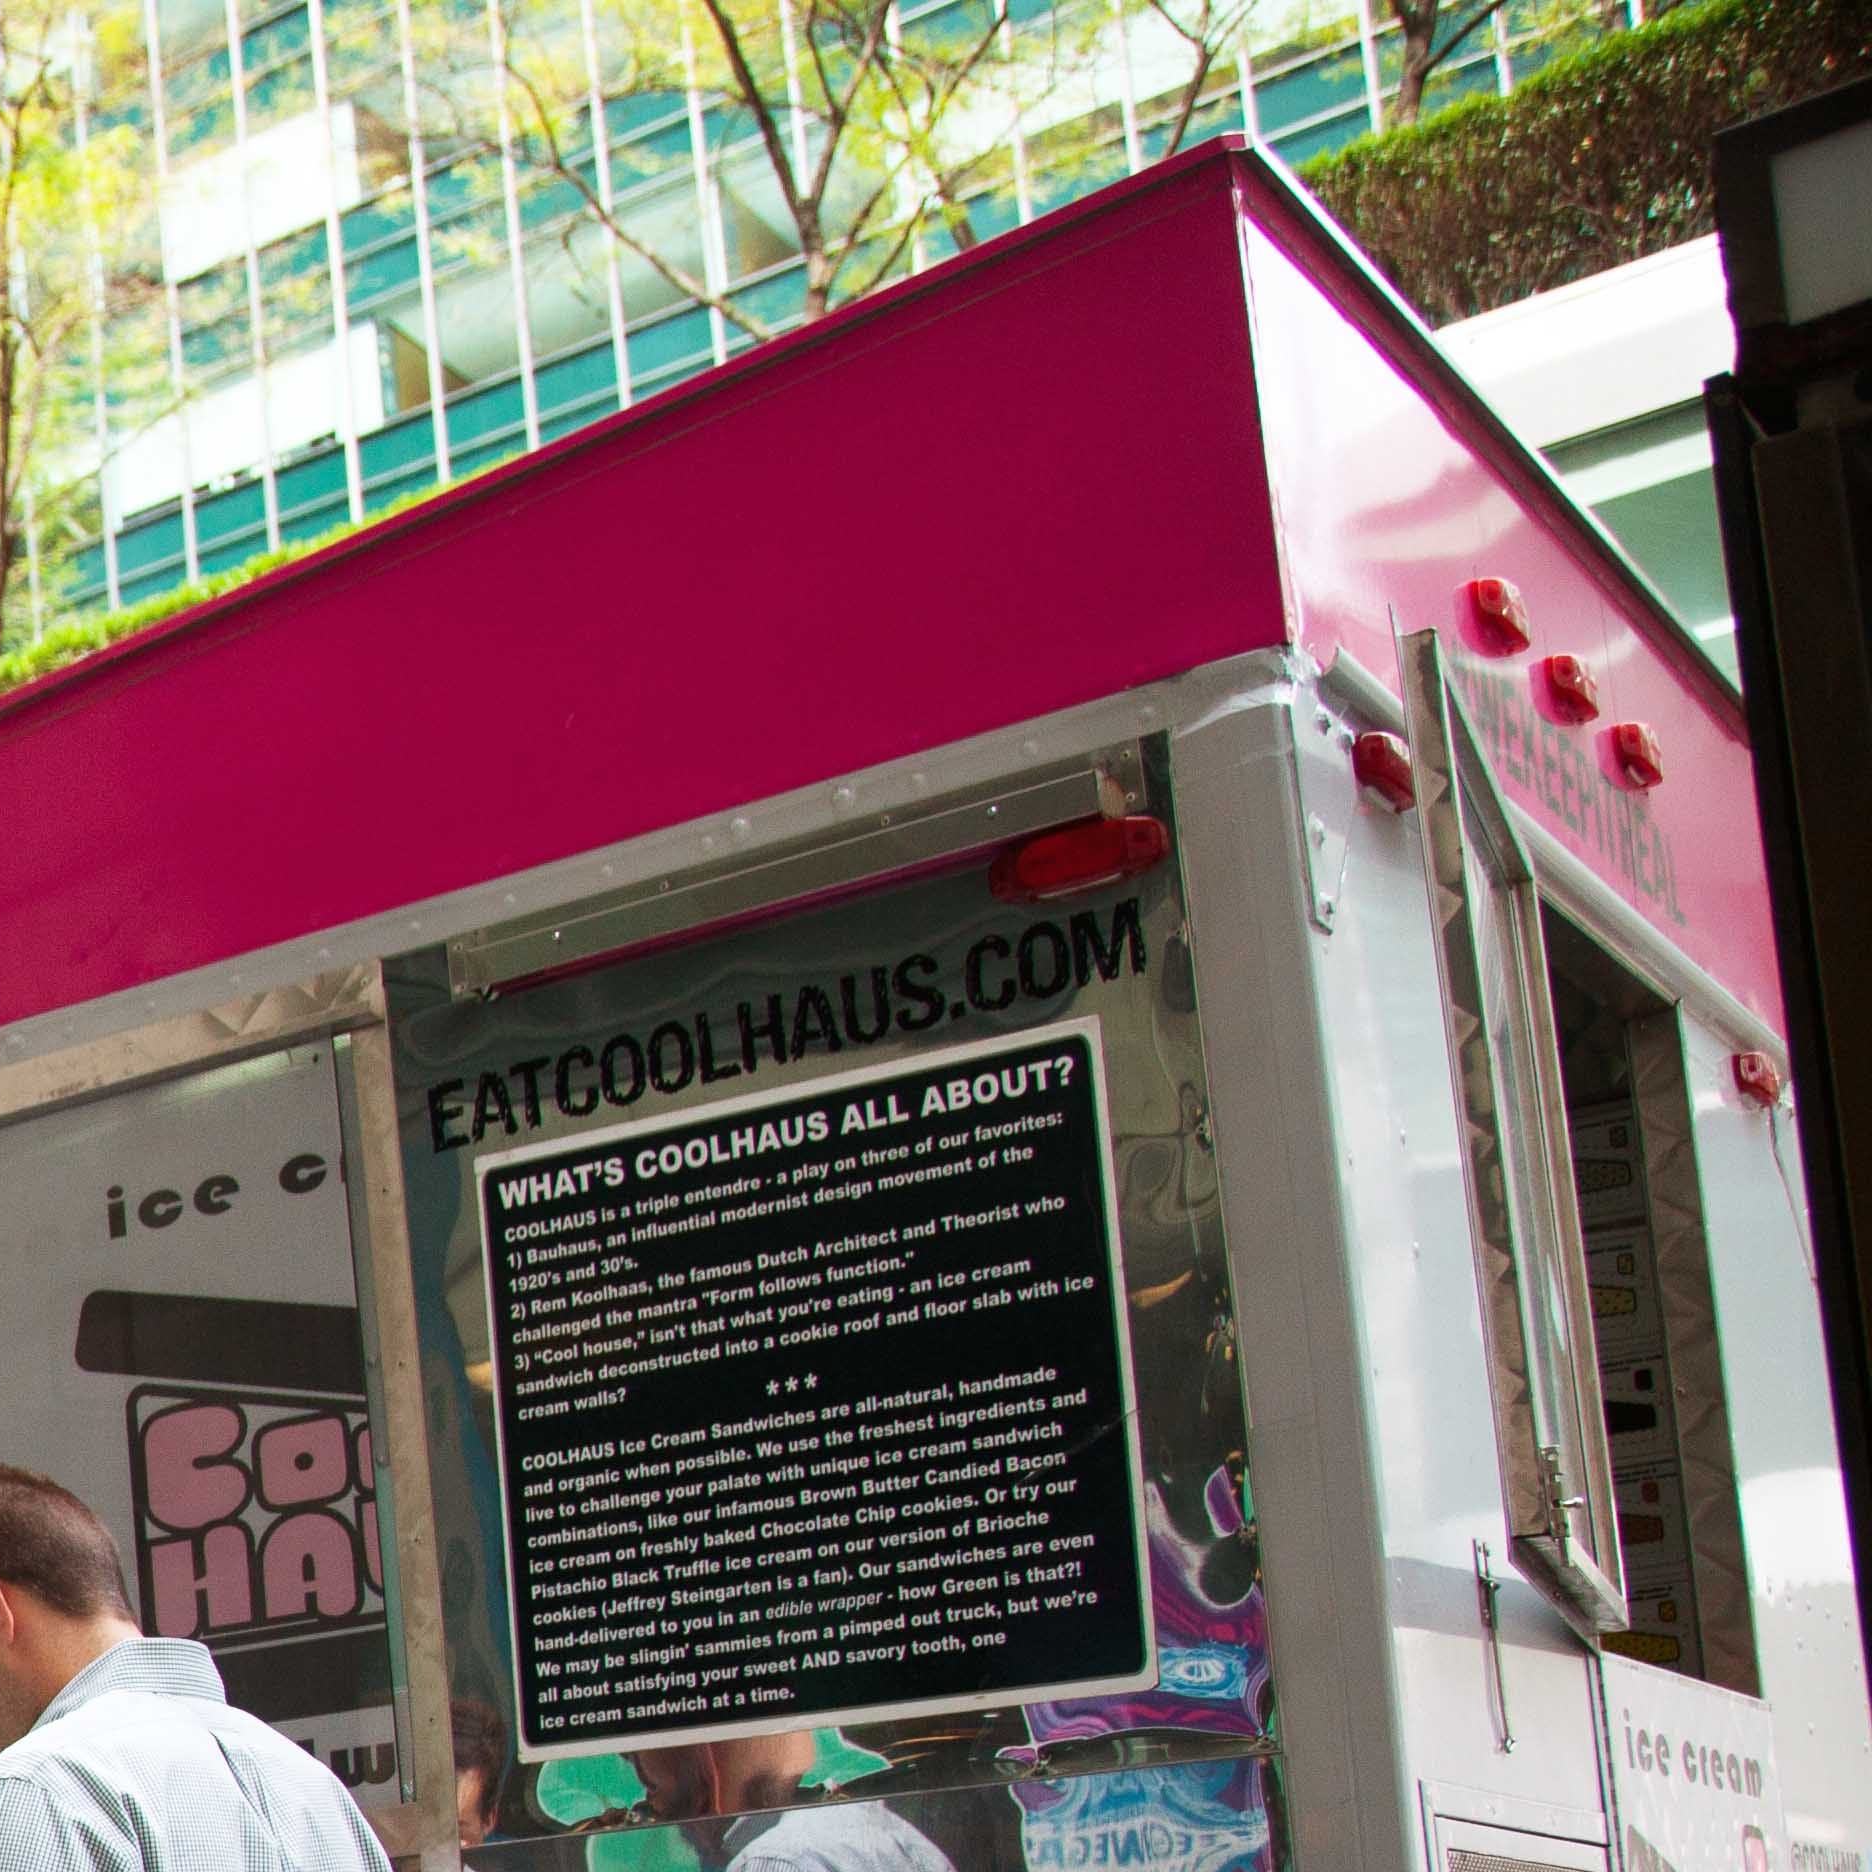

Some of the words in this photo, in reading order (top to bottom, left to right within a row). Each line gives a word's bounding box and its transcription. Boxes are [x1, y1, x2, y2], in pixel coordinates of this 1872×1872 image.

[426, 897, 1147, 1155] EATCOOLHAUS.COM
[497, 1156, 625, 1210] WHAT'S
[634, 1110, 829, 1179] COOLHAUS
[839, 1093, 910, 1135] ALL
[919, 1054, 1074, 1118] ABOUT?
[503, 1208, 597, 1243] COOLHAUS
[600, 1206, 616, 1223] is
[619, 1205, 631, 1219] a
[634, 1193, 680, 1215] triple
[683, 1177, 761, 1205] entendre
[776, 1171, 788, 1185] a
[791, 1161, 829, 1185] play
[833, 1156, 856, 1172] on
[859, 1145, 910, 1167] three
[914, 1135, 933, 1155] of
[937, 1131, 969, 1150] our
[973, 1111, 1063, 1142] favorites:
[105, 1174, 240, 1241] ice
[277, 1152, 345, 1196] c
[505, 1251, 522, 1270] 1)
[525, 1238, 602, 1264] Bauhaus,
[605, 1232, 627, 1248] an
[630, 1209, 716, 1242] influential
[719, 1190, 809, 1223] modernist
[812, 1180, 872, 1204] design
[877, 1156, 973, 1190] movement
[976, 1149, 996, 1169] of
[1001, 1145, 1033, 1164] the
[509, 1302, 527, 1321] 2)
[529, 1296, 567, 1315] Rem
[570, 1280, 653, 1307] Koolhaas,
[656, 1272, 685, 1289] the
[688, 1259, 752, 1283] famous
[756, 1245, 809, 1270] Dutch
[812, 1227, 897, 1259] Architect
[901, 1218, 936, 1240] and
[939, 1202, 1020, 1232] Theorist
[1023, 1195, 1065, 1215] who
[508, 1270, 561, 1293] 1920's
[565, 1261, 596, 1282] and
[599, 1254, 638, 1275] 30's.
[511, 1312, 601, 1345] challenged
[604, 1308, 633, 1326] the
[636, 1296, 698, 1321] mantra
[700, 1285, 754, 1306] "Form
[757, 1272, 822, 1296] follows
[825, 1249, 914, 1283] function."
[1624, 1707, 1671, 1777] ice
[1681, 1739, 1762, 1799] cream
